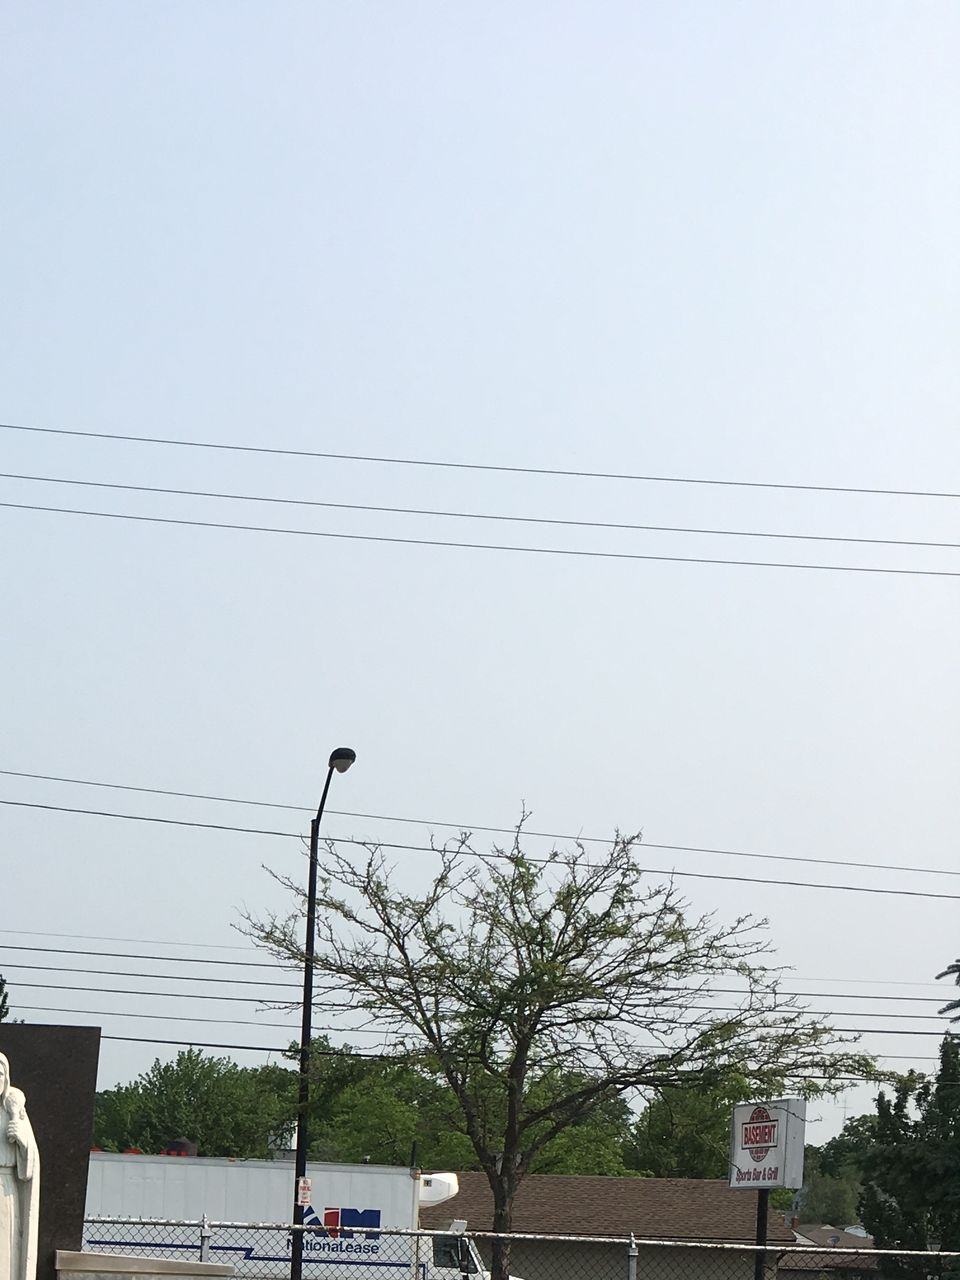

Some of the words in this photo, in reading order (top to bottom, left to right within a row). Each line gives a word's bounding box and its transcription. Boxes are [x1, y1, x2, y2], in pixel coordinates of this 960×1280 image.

[743, 1124, 777, 1145] BASEMENT
[736, 1169, 752, 1184] Sports
[286, 1238, 380, 1254] NtionaLease
